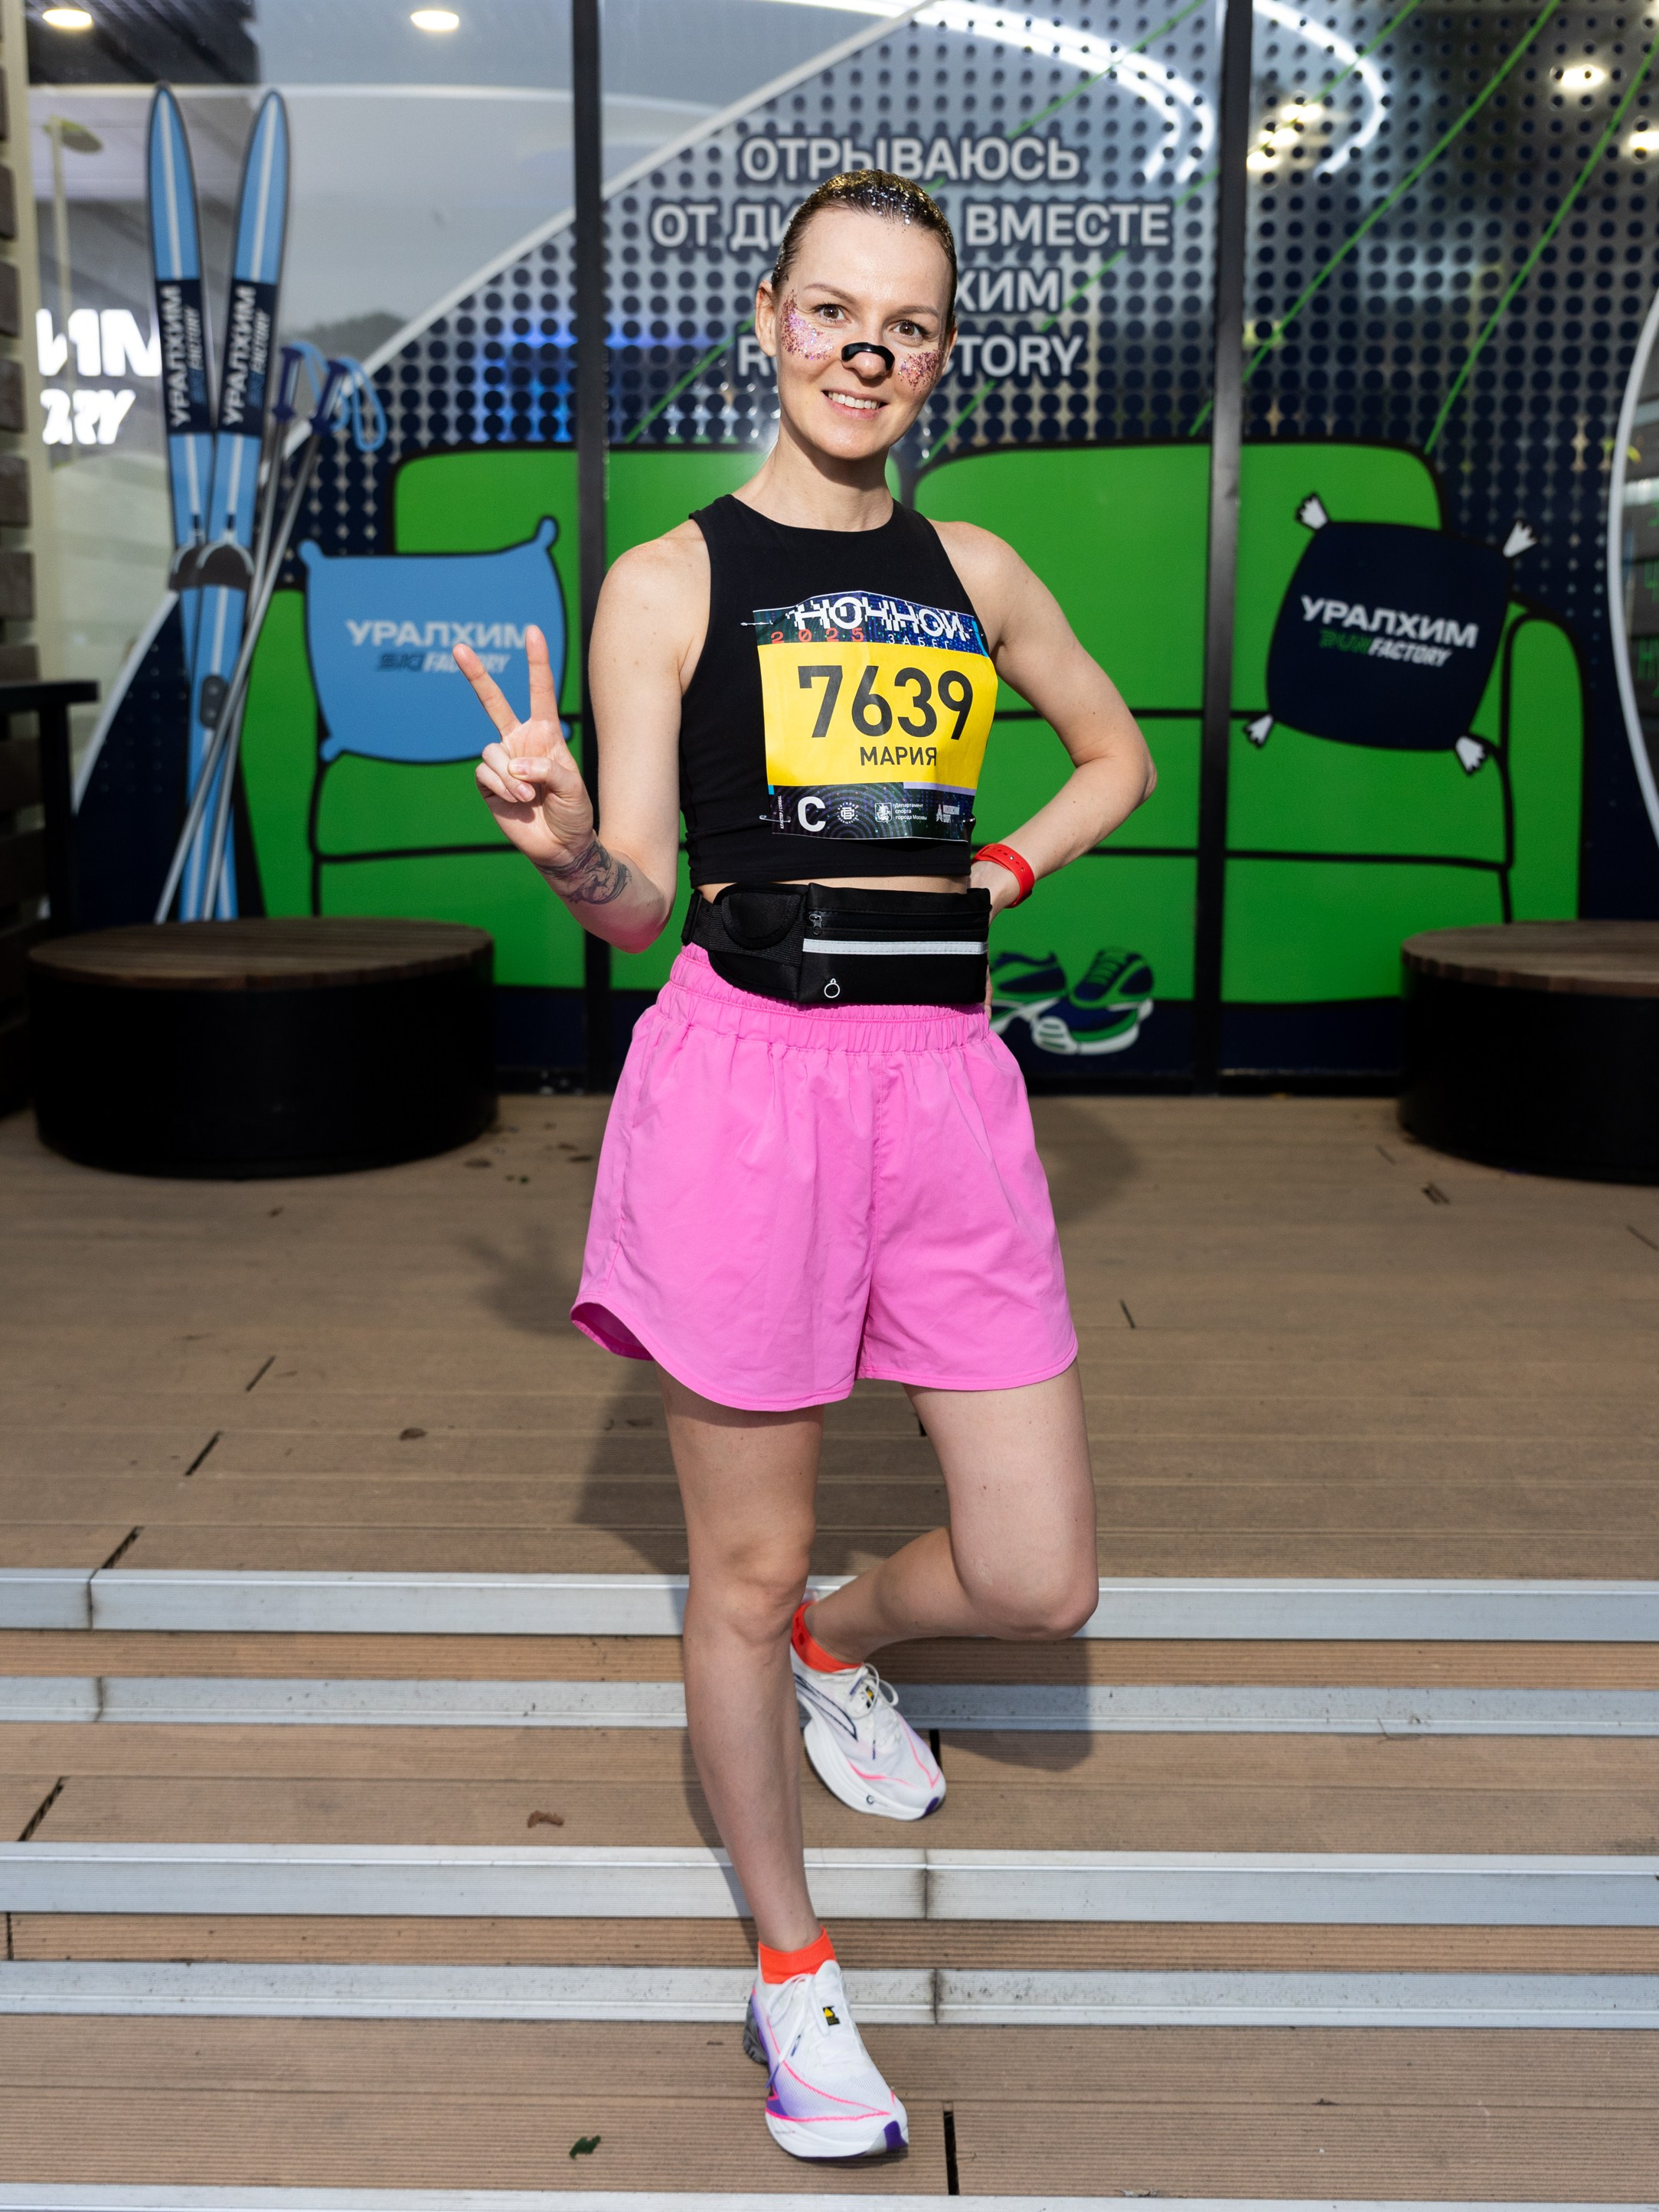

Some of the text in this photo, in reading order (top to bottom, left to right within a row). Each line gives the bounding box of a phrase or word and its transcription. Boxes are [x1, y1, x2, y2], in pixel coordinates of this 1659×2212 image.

[742, 137, 1080, 181] ОТРЫВАЮСЬ
[652, 203, 718, 248] ОТ
[966, 204, 1171, 246] ВМЕСТЕ
[160, 285, 191, 427] УРАЛХИМ
[222, 285, 256, 426] УРАЛХИМ
[943, 334, 1084, 377] TORY
[346, 620, 527, 648] УРАЛХИМ
[770, 628, 864, 644] 2025
[888, 634, 950, 650] ЗАБЕГ
[1301, 595, 1479, 648] УРАЛХИМ
[1368, 637, 1452, 667] FACTORY
[797, 665, 973, 740] 7639
[860, 746, 937, 766] МАРИЯ
